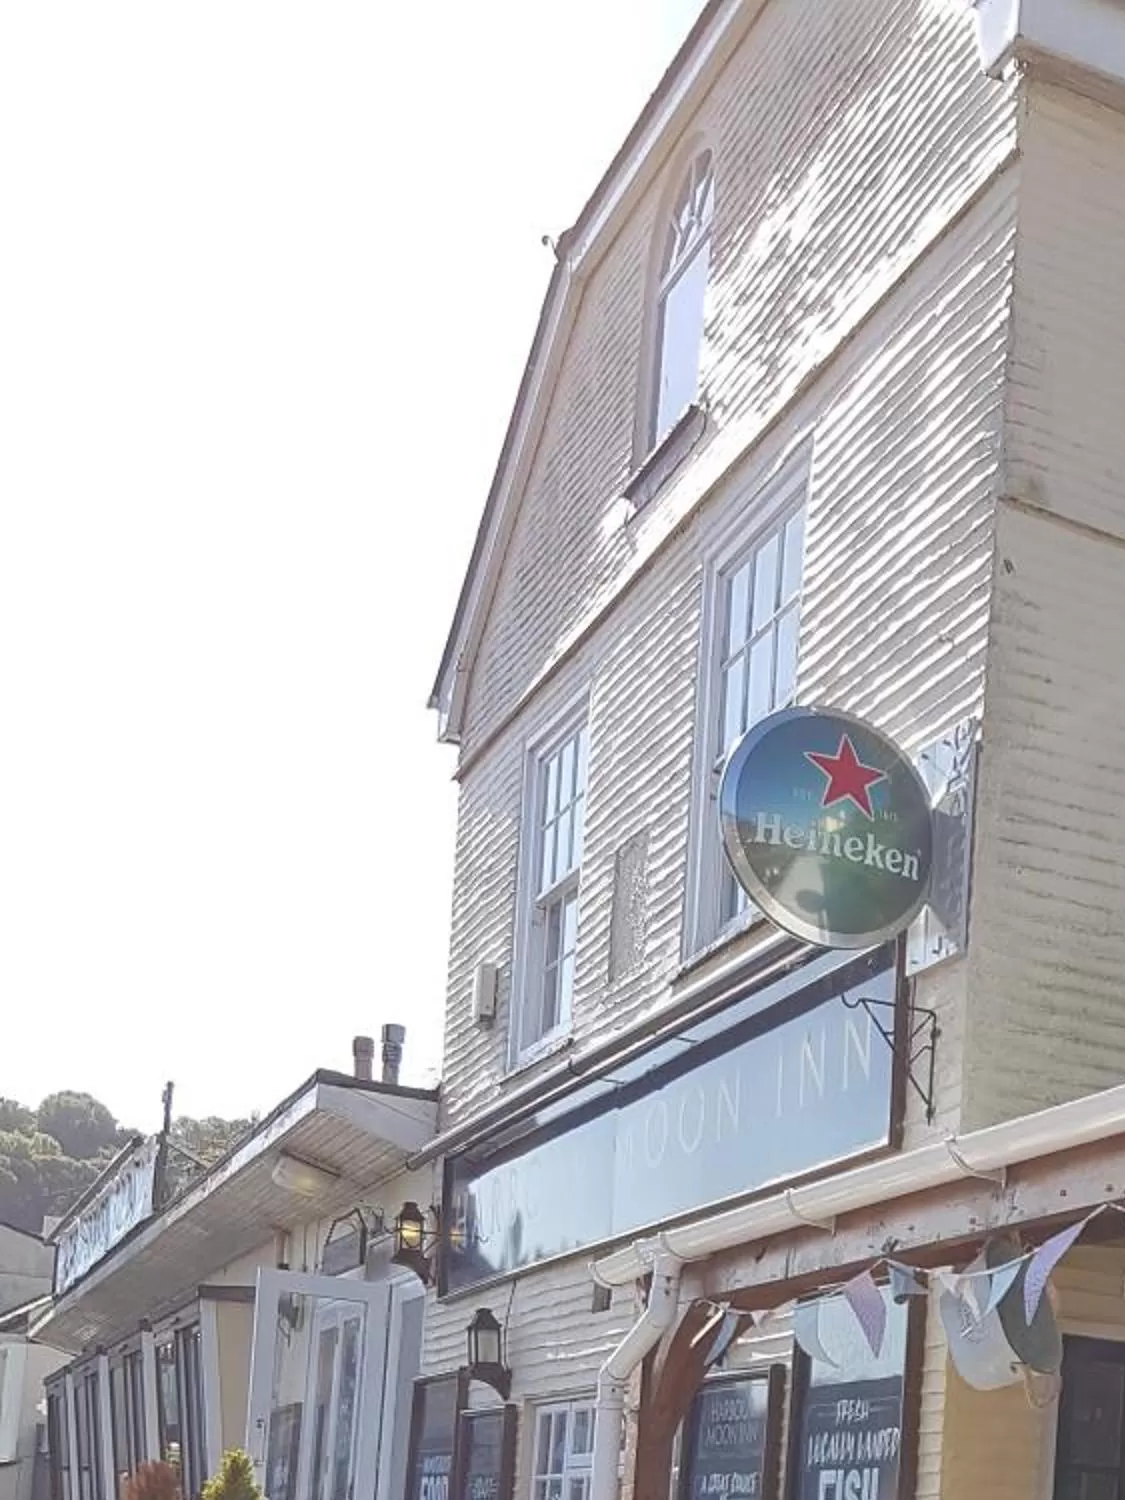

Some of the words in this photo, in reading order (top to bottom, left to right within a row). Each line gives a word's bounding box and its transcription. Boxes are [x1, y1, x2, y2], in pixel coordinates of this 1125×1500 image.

[755, 811, 920, 881] Heineken
[615, 1066, 742, 1170] MOON
[773, 1008, 874, 1119] INN
[835, 1397, 869, 1424] FRESH
